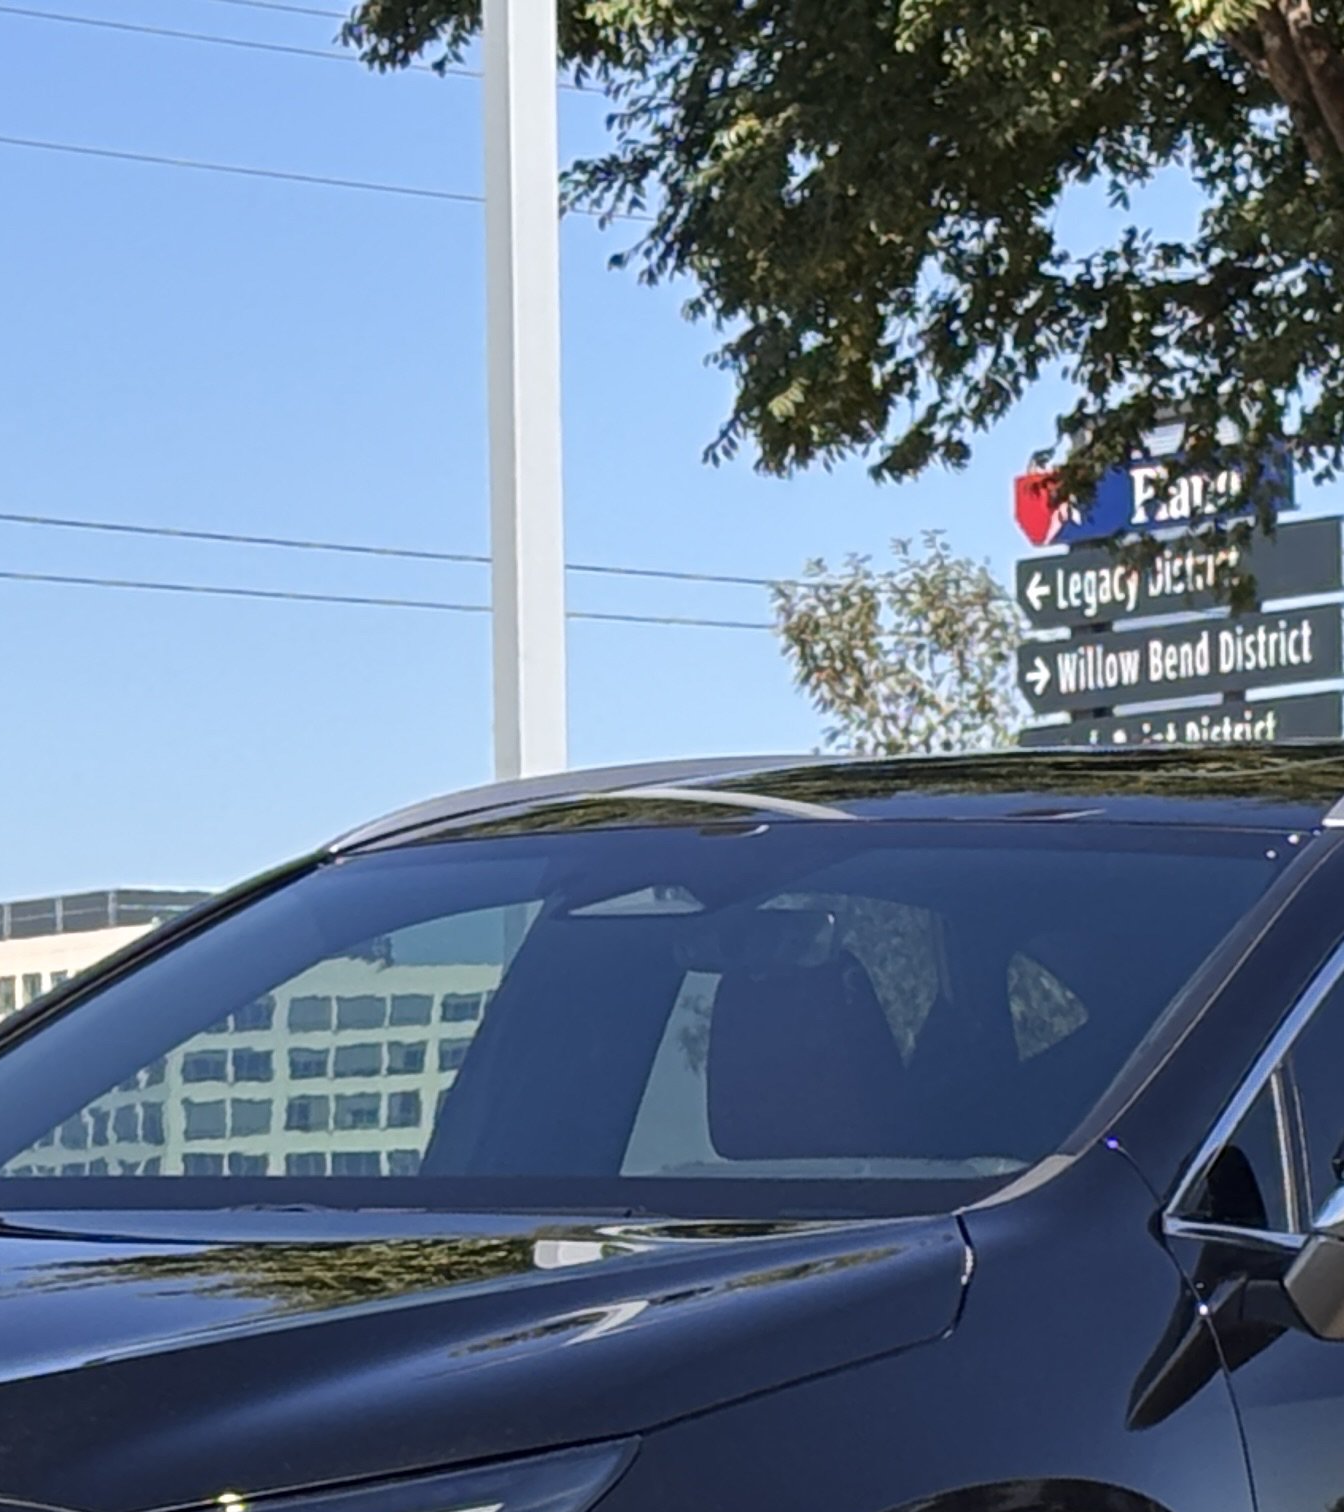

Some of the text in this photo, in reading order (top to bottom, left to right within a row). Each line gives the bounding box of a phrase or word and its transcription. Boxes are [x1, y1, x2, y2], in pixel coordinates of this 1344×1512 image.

[1056, 563, 1140, 618] Legacy
[1057, 619, 1313, 694] Willow Bend District
